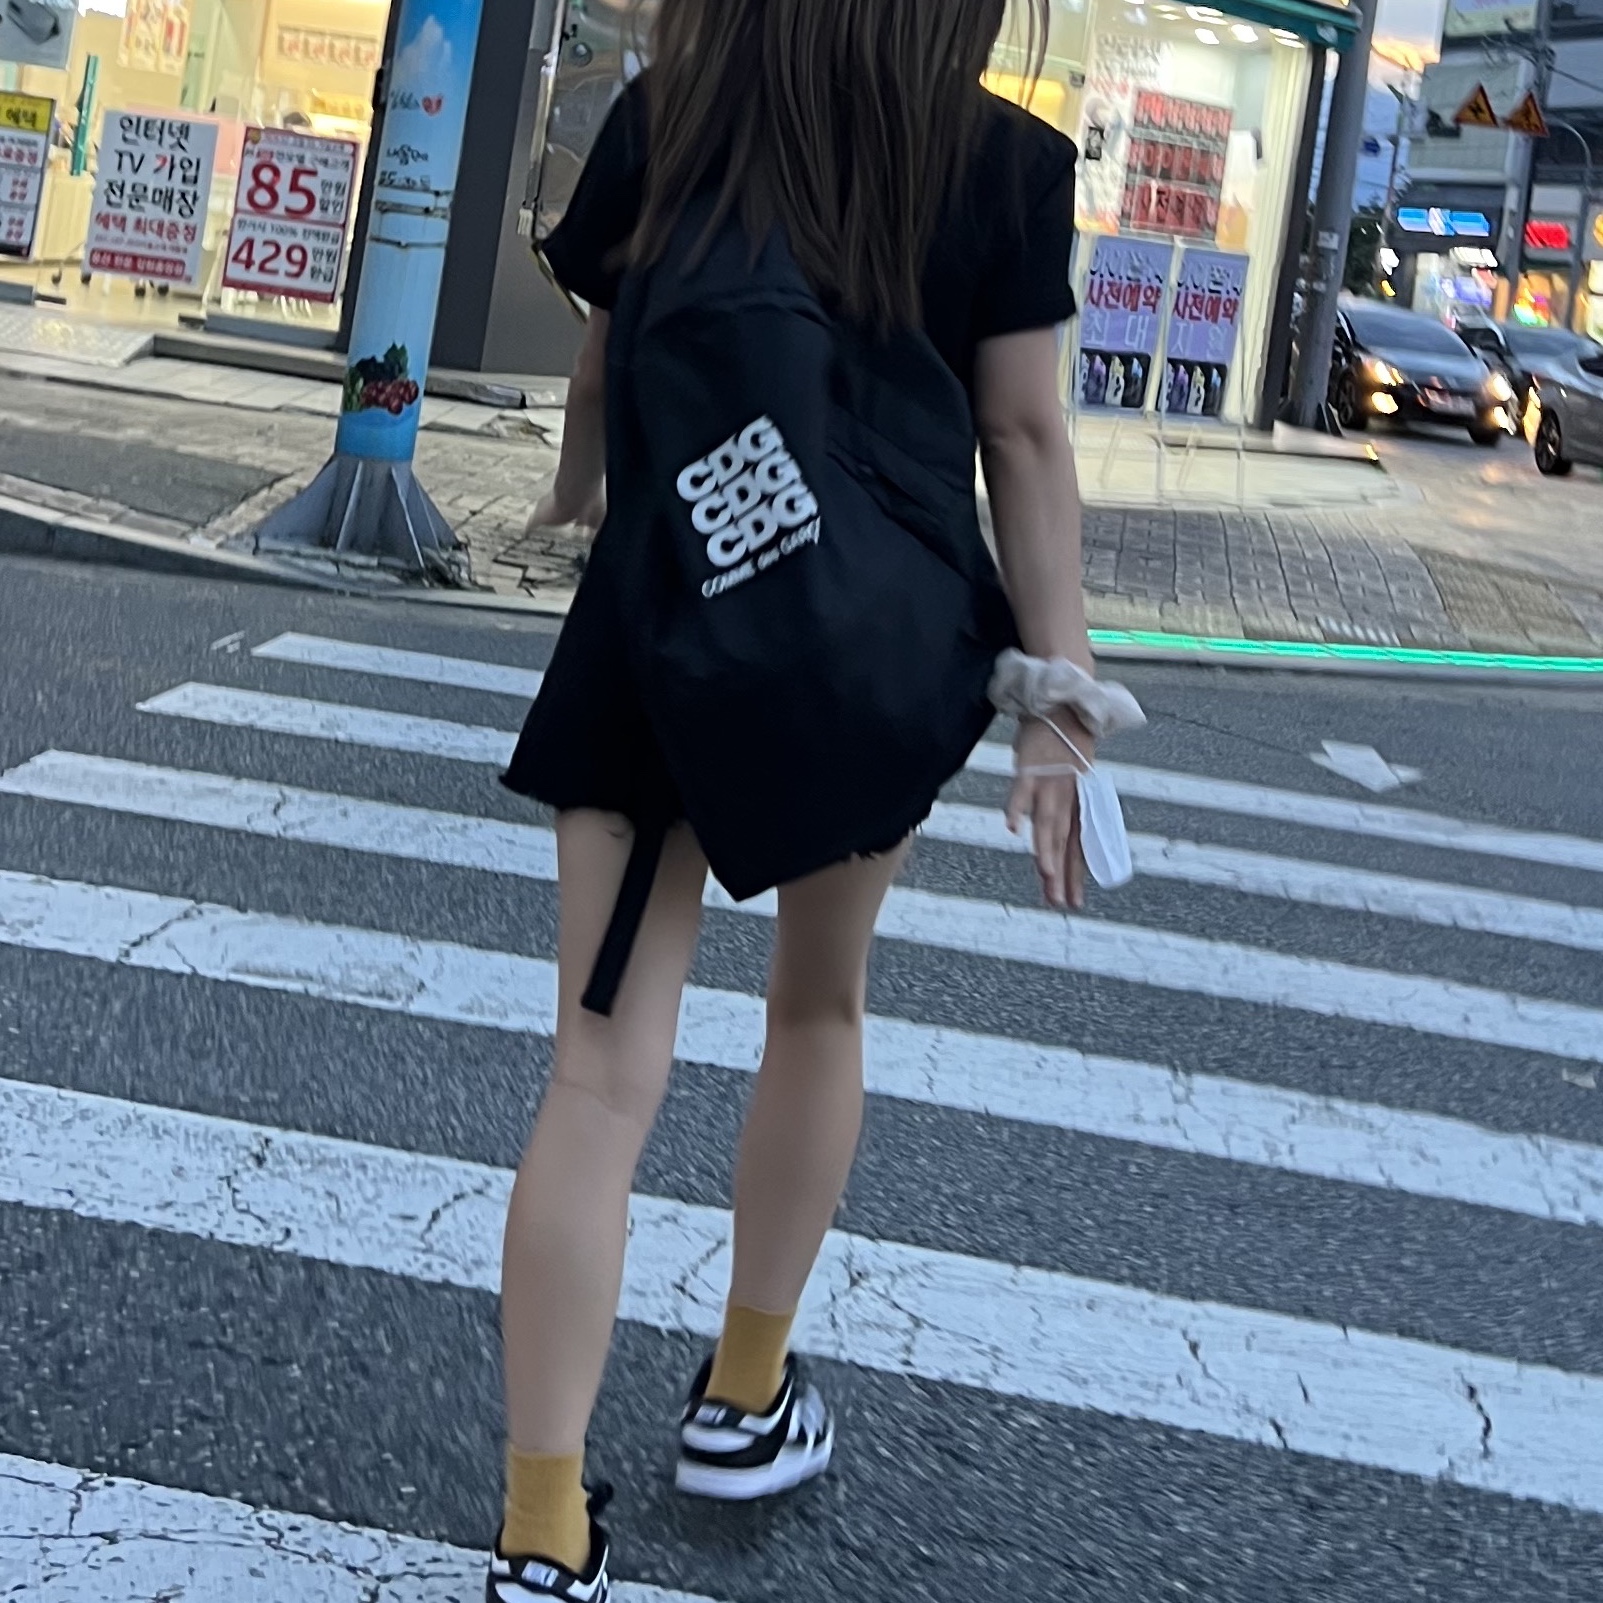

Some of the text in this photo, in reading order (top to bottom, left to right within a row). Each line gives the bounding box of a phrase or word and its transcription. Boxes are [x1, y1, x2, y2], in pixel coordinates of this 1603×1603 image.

[119, 116, 190, 153] 인터넷
[114, 149, 201, 185] TV 가입
[104, 179, 200, 219] 전문매장
[246, 160, 319, 219] 85
[231, 235, 309, 280] 429
[1087, 278, 1163, 315] 사전예약
[1172, 290, 1240, 326] 사전예약
[676, 414, 784, 502] CDG
[691, 450, 801, 535] CDG
[706, 483, 819, 568] CDG
